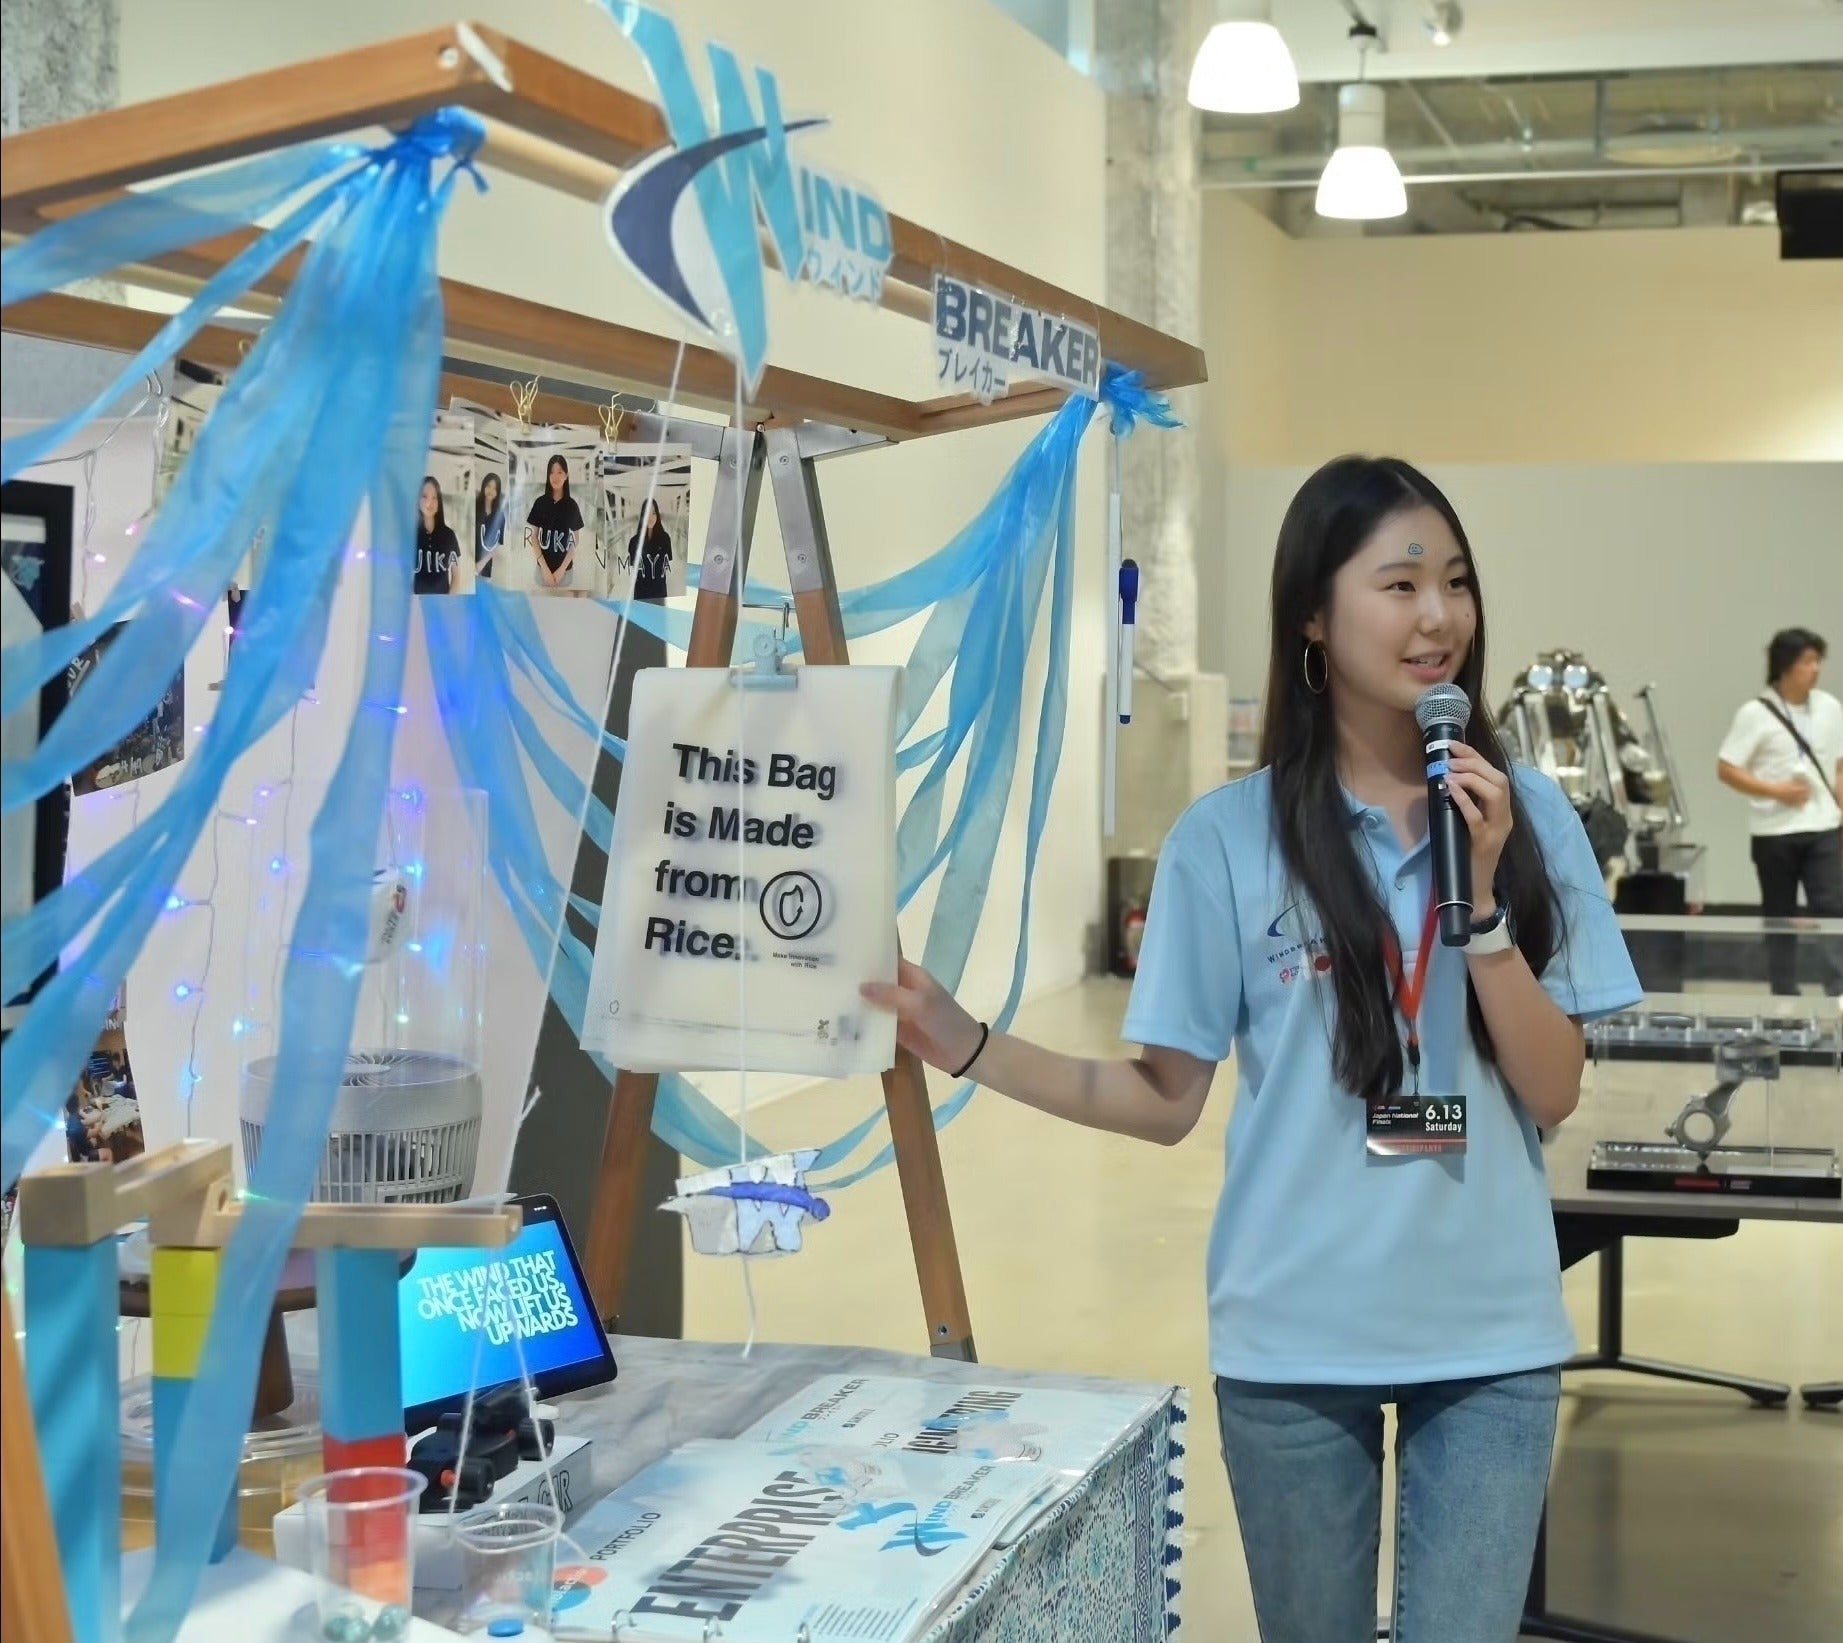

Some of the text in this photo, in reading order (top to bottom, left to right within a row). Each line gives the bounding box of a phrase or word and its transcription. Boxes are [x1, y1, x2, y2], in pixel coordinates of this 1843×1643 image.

[598, 0, 890, 390] WIND
[936, 278, 1099, 388] BREAKER
[523, 526, 576, 554] RUKA
[617, 553, 671, 579] MAYA
[673, 742, 836, 801] This Bag
[663, 801, 814, 849] is Made
[654, 859, 747, 902] from
[1425, 1099, 1463, 1120] 6.13
[1425, 1121, 1463, 1133] Saturday
[417, 1249, 557, 1301] THE WIND THAT
[417, 1289, 475, 1320] ONCE
[472, 1276, 533, 1308] FACED
[456, 1286, 571, 1333] NOW LIFT US
[801, 1379, 869, 1420] BREAKER
[943, 1465, 997, 1500] BREAKER
[589, 1512, 661, 1561] PORTFOLIO
